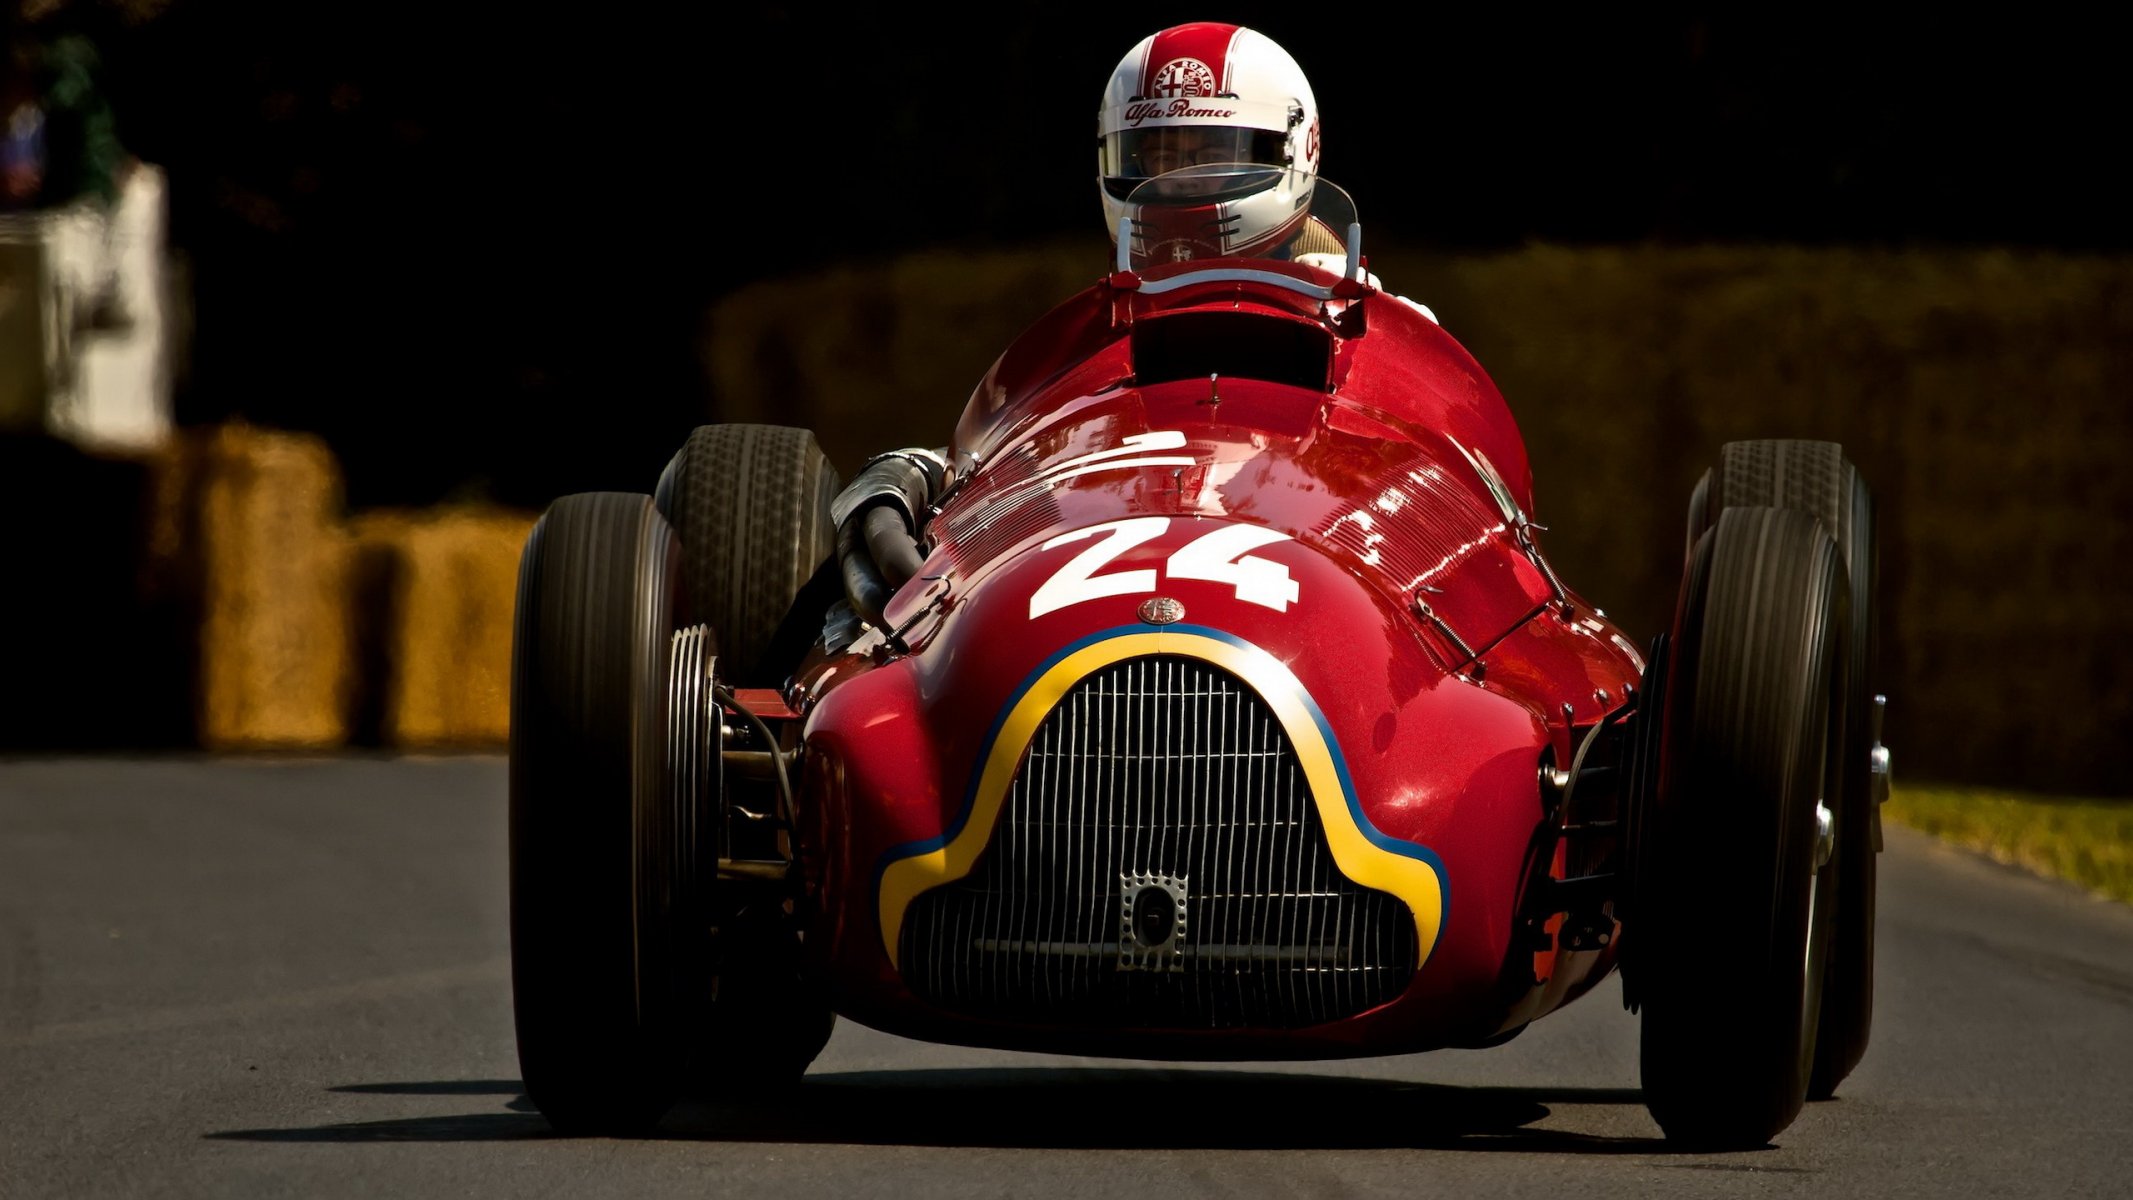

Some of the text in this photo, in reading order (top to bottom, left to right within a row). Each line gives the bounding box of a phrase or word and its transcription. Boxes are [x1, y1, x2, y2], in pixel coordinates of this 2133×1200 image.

[1155, 65, 1177, 90] ALFA
[1125, 99, 1236, 127] Alfa Romeo
[1029, 516, 1300, 620] 24
